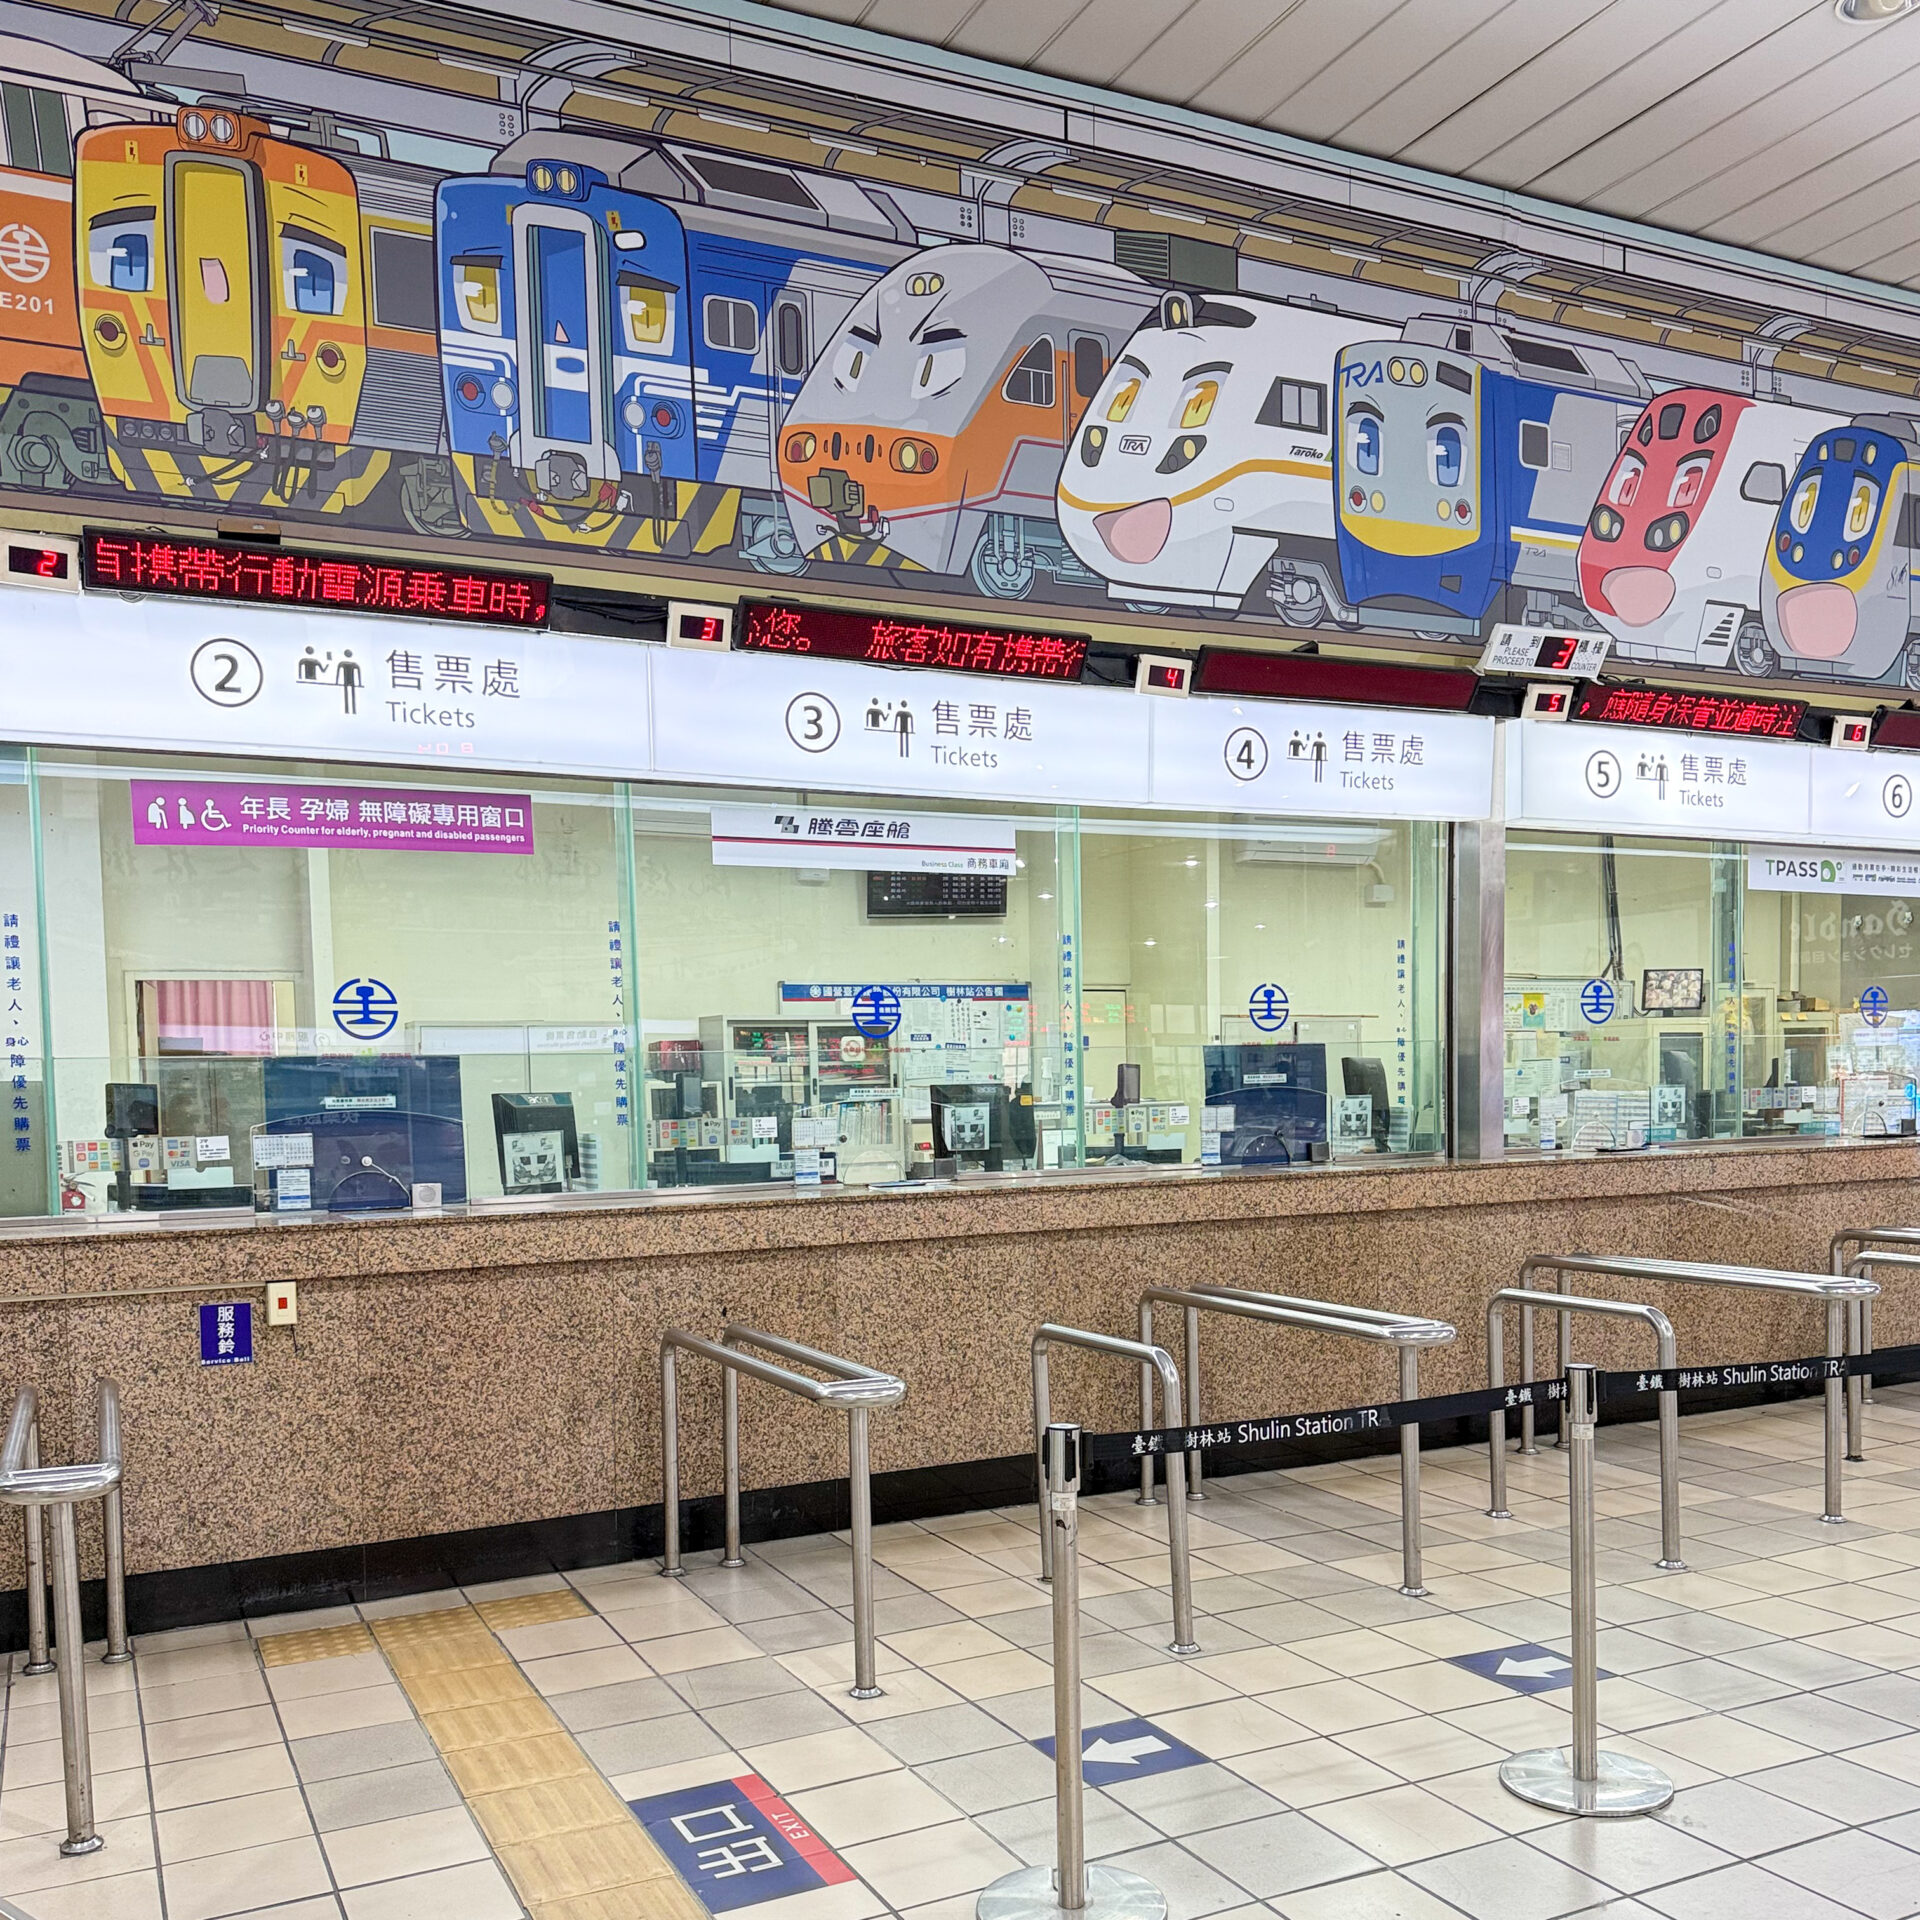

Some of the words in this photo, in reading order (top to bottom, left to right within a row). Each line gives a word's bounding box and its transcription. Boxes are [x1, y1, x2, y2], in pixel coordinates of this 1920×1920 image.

[0, 291, 54, 315] E201
[1340, 361, 1385, 388] TRA
[1123, 437, 1148, 454] TRA
[1288, 444, 1324, 460] Taroko
[39, 550, 57, 576] 2
[701, 618, 716, 641] 3
[1493, 656, 1524, 666] PROCEED
[1524, 658, 1535, 667] TO
[1504, 647, 1530, 657] PLEASE
[1552, 638, 1577, 669] 3
[385, 649, 521, 699] 售票處
[1165, 667, 1178, 688] 4
[1549, 694, 1560, 712] 5
[385, 701, 476, 729] Tickets
[931, 700, 1033, 742] 售票處
[1852, 724, 1863, 741] 6
[931, 745, 998, 769] Tickets
[1341, 730, 1425, 767] 售票處
[1340, 771, 1395, 791] Tickets
[1680, 753, 1747, 787] 售票處
[1679, 789, 1724, 808] Tickets
[239, 795, 291, 820] 年長
[300, 797, 349, 822] 孕婦
[358, 799, 525, 828] 無障礙專用窗口
[243, 824, 279, 836] Priority
[281, 824, 319, 836] Counter
[321, 825, 334, 835] for
[337, 827, 371, 839] elderly,
[373, 829, 414, 840] pregnant
[416, 829, 433, 838] and
[434, 830, 473, 840] disabled
[475, 833, 525, 843] passengers
[808, 817, 912, 840] 騰雲座艙
[921, 859, 947, 869] Business
[948, 861, 964, 869] Class
[967, 857, 1010, 870] 商務車廂
[1765, 859, 1818, 878] TPASS
[171, 1160, 191, 1168] VISA
[217, 1305, 235, 1355] 服務鈴
[1636, 1373, 1663, 1392] 臺鐵
[1678, 1371, 1718, 1389] 樹林站
[1723, 1367, 1767, 1386] Shulin
[1771, 1363, 1818, 1383] Station
[1504, 1387, 1533, 1407] 臺鐵
[1131, 1435, 1164, 1456] 臺鐵
[1184, 1428, 1232, 1450] 樹林站
[1238, 1422, 1290, 1444] Shulin
[1295, 1415, 1354, 1439] Station
[1357, 1409, 1391, 1429] TR
[771, 1811, 810, 1840] EXIT
[670, 1803, 783, 1880] 出口
